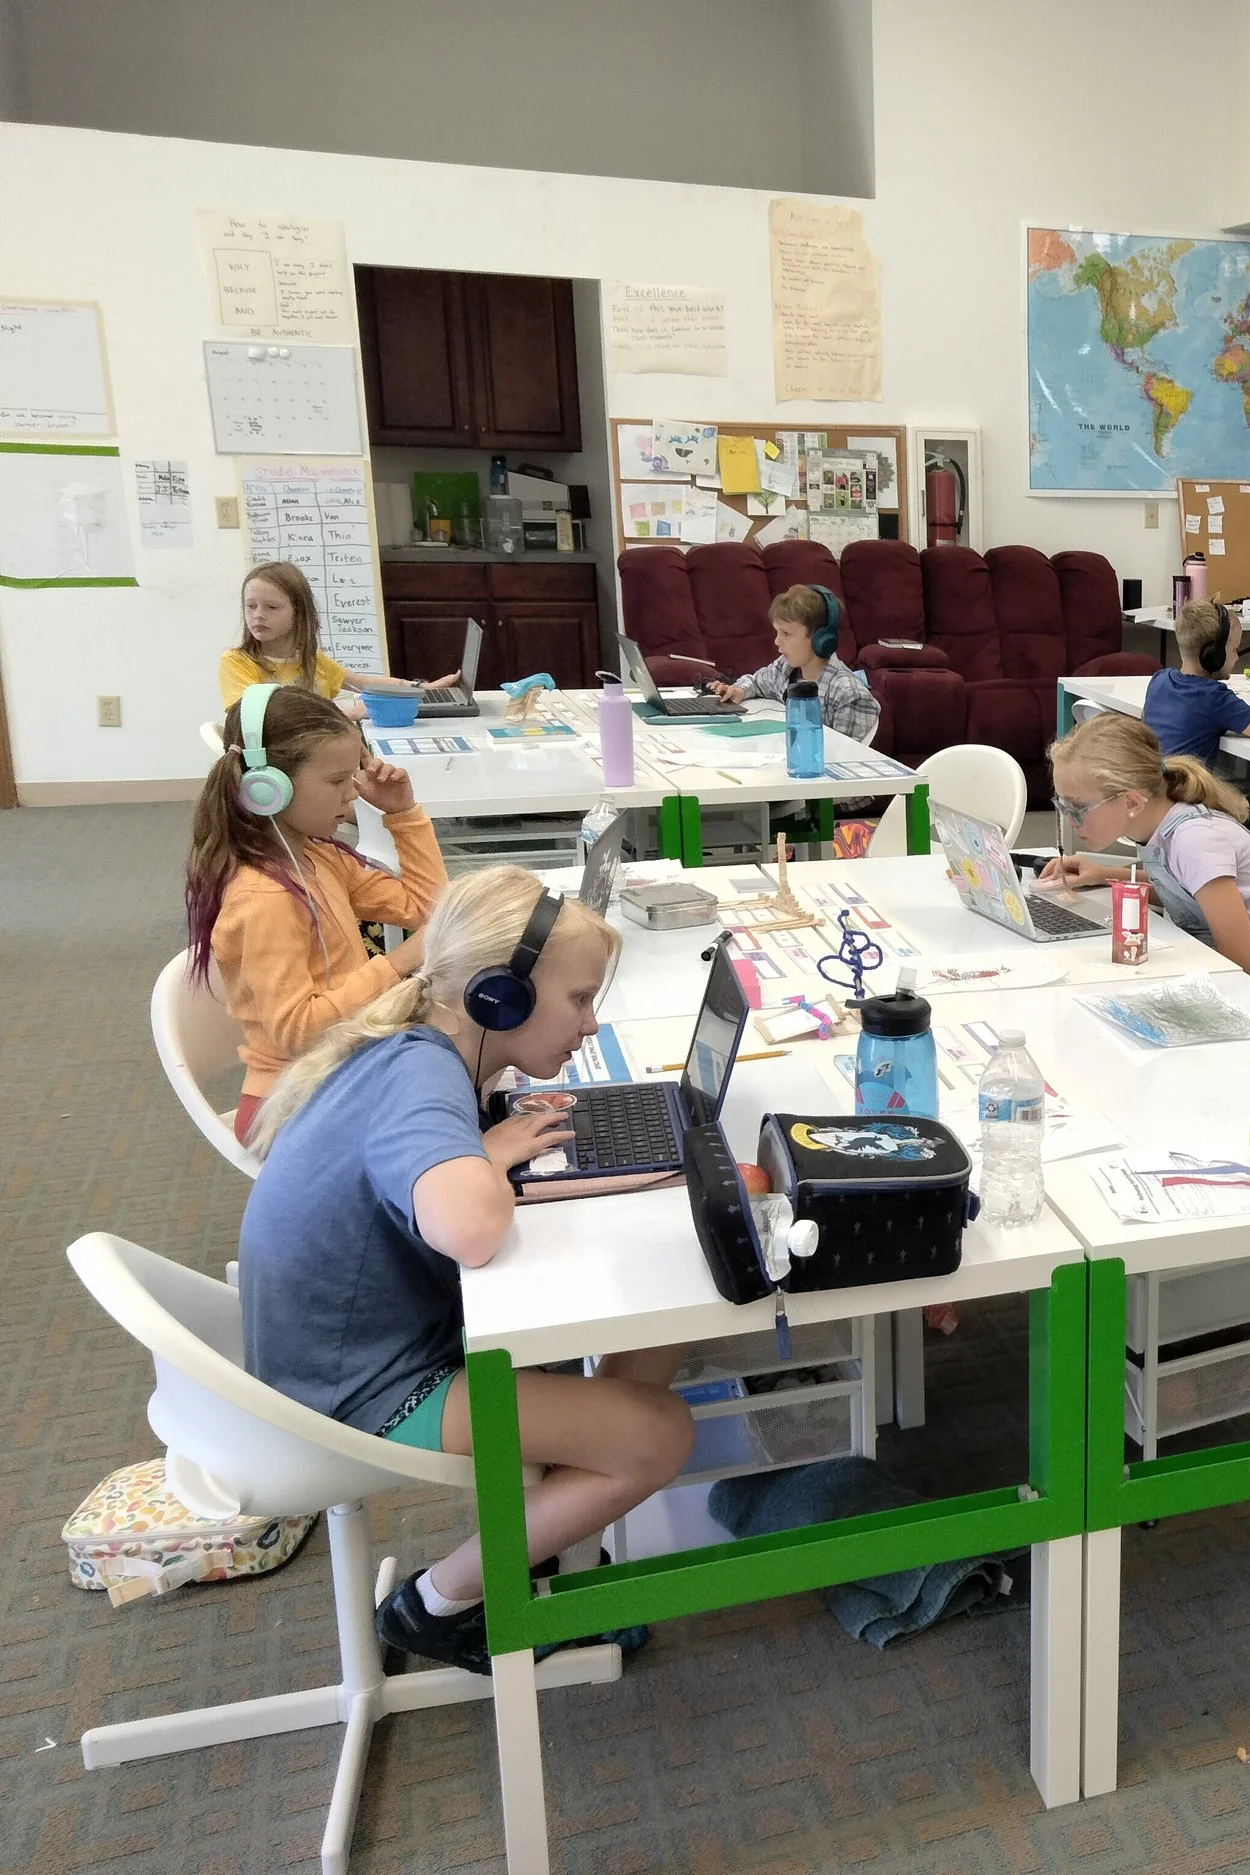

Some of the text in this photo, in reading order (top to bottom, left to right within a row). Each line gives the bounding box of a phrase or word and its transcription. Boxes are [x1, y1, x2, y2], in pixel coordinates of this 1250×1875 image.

[228, 263, 250, 272] WHY
[222, 286, 258, 295] BECAUSE
[625, 285, 687, 298] Excellence
[234, 307, 256, 316] AND
[250, 328, 262, 336] BE
[1078, 423, 1132, 432] THE WORLD
[255, 465, 361, 479] Studio Maintenance
[334, 593, 372, 608] Everest
[332, 616, 366, 625] Sawyer
[337, 624, 374, 634] Jackson
[336, 642, 375, 653] Everyone
[478, 992, 502, 1005] SONY
